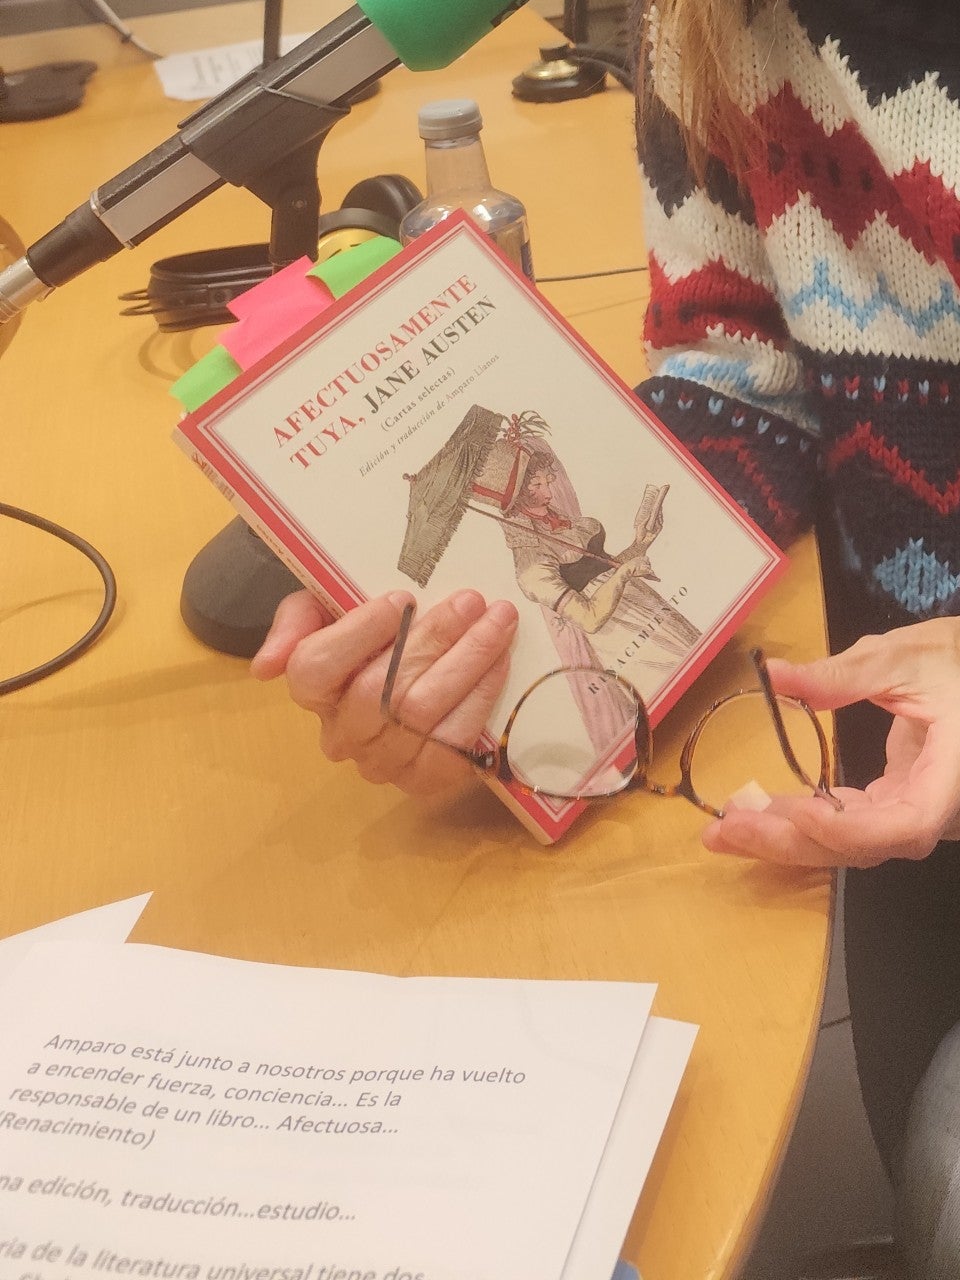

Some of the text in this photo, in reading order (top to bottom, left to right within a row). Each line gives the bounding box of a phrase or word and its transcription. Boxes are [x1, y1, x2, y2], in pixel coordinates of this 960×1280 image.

[272, 274, 478, 448] AFECTUOSAMENTE
[289, 295, 497, 470] TUYA, JANE AUSTEN
[359, 449, 390, 478] Edición
[397, 409, 436, 446] traducción
[446, 375, 475, 402] Amparo
[473, 353, 501, 377] Llanos
[380, 365, 457, 433] (Cartas selectas)
[27, 1061, 402, 1108] a encender fuerza, conciencia... Es la
[44, 1034, 526, 1085] Amparo está junto a nosotros porque ha vuelto
[9, 1087, 400, 1135] responsable de un libro... Afectuosa...
[27, 1176, 112, 1208] edición,
[30, 1240, 63, 1264] de
[65, 1243, 89, 1269] la
[91, 1247, 202, 1278] literatura
[206, 1261, 314, 1280] universal
[317, 1263, 377, 1280] tiene
